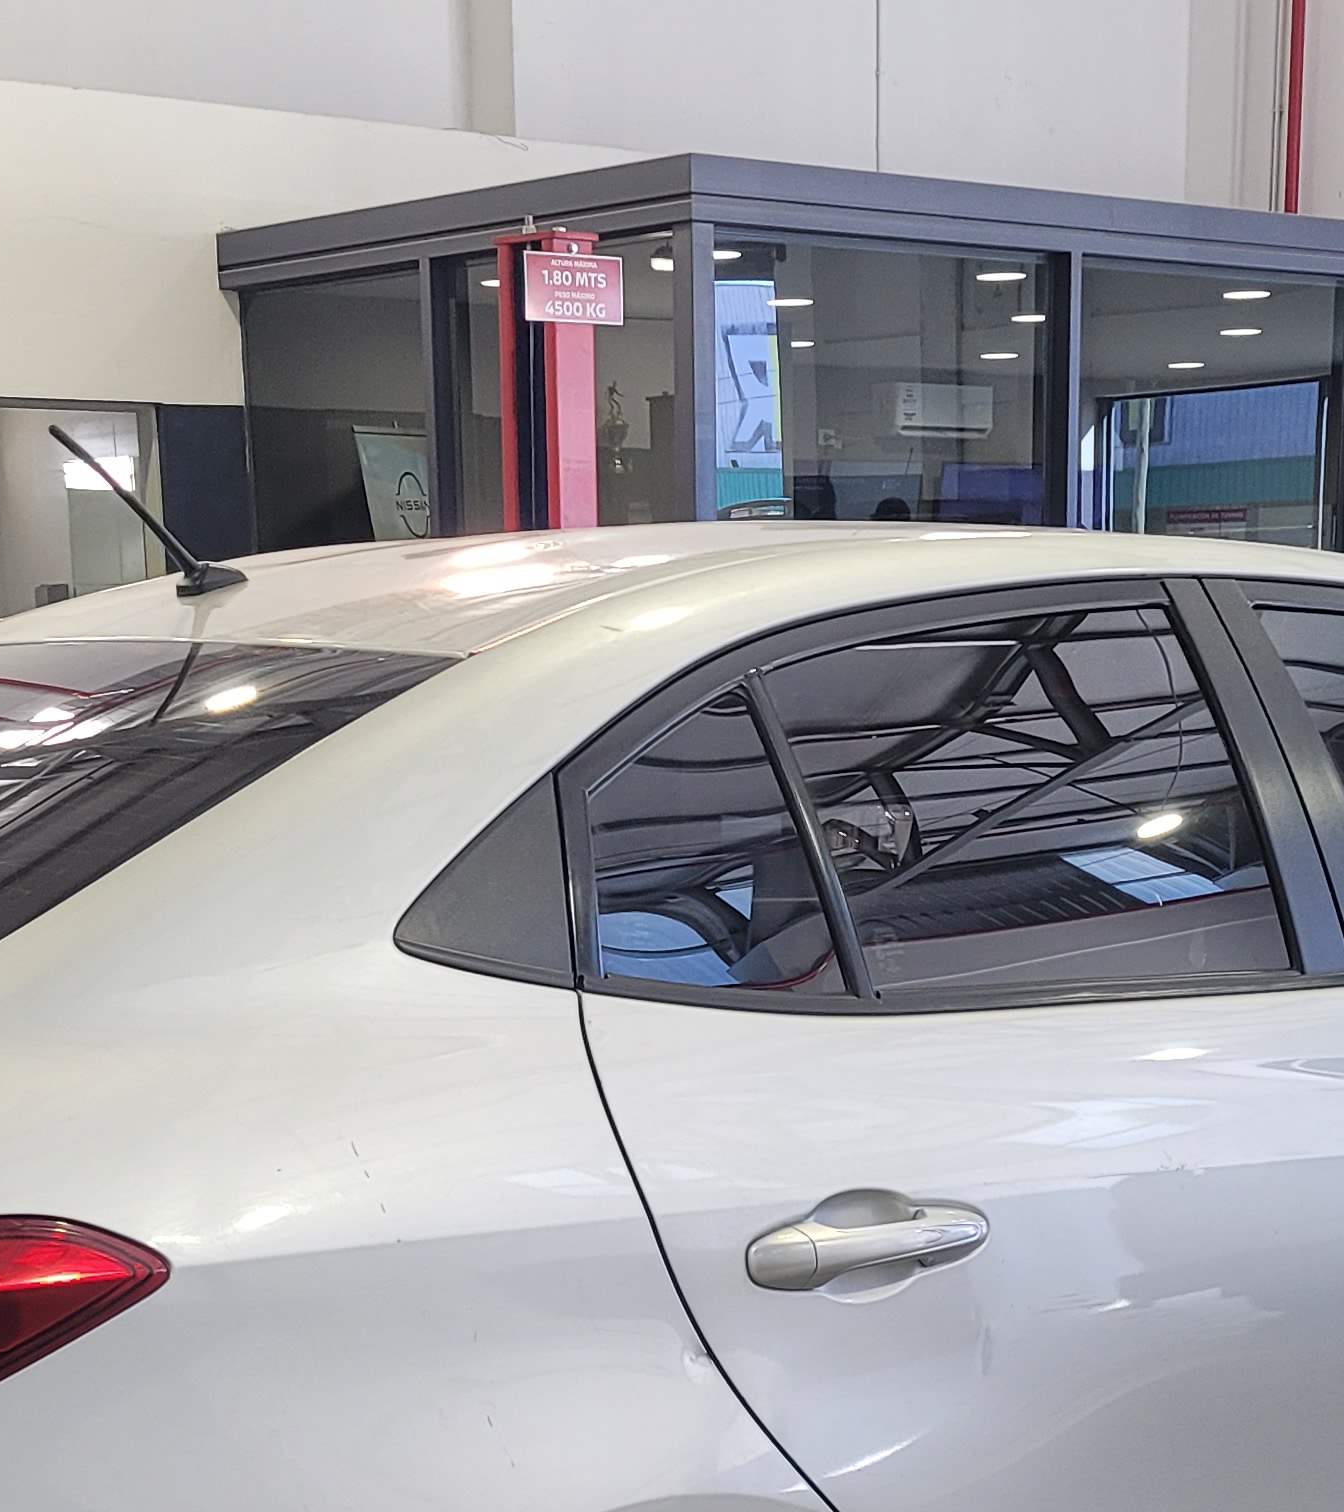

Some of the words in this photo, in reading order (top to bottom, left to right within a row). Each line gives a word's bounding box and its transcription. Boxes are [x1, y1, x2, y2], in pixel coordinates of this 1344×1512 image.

[550, 258, 573, 267] ALTURA
[541, 269, 572, 286] 1.80
[576, 271, 607, 289] MTS
[554, 290, 571, 298] PESO
[544, 300, 583, 316] 4500
[586, 302, 606, 318] KG
